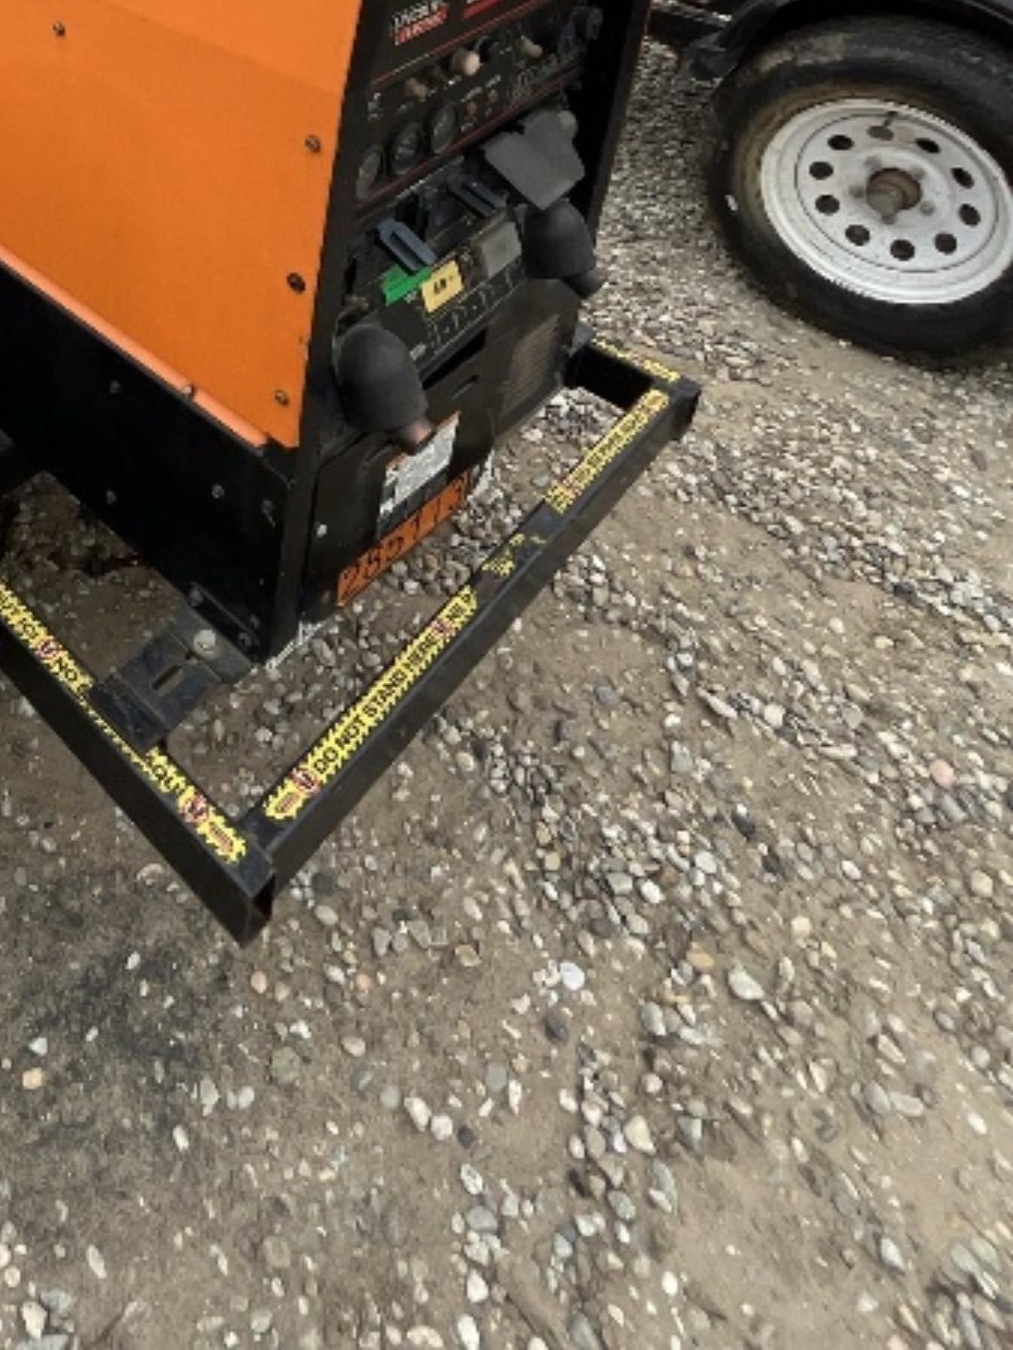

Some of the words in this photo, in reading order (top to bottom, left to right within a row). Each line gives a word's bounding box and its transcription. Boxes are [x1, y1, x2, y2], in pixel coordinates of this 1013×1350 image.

[314, 746, 340, 774] DO
[337, 714, 368, 747] NOT
[363, 669, 409, 717] STAND
